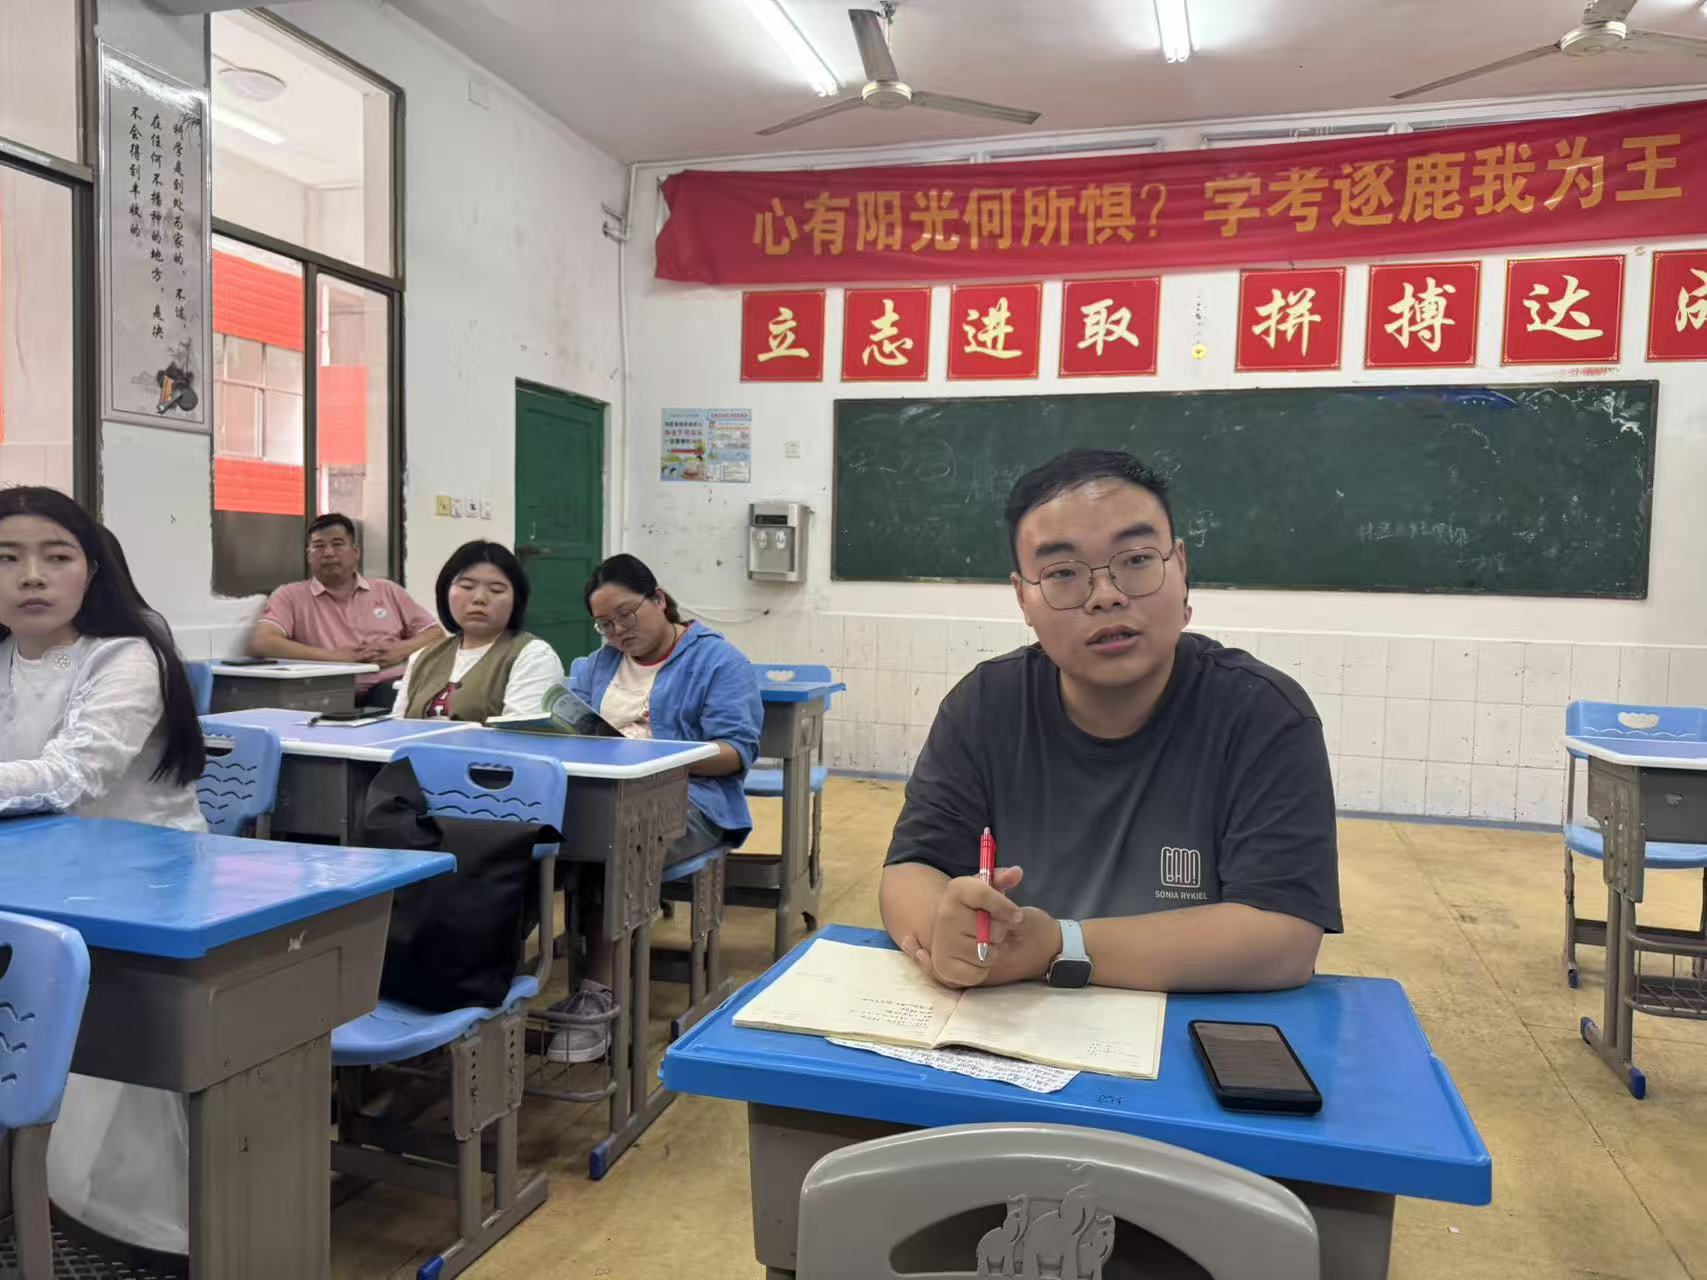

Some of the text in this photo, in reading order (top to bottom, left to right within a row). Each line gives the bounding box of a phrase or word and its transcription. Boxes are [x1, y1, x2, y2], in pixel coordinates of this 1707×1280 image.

[753, 134, 1683, 256] 心有阳光何所惧？ 学考逐鹿我为王
[1155, 890, 1208, 900] SONIA RYKIEL
